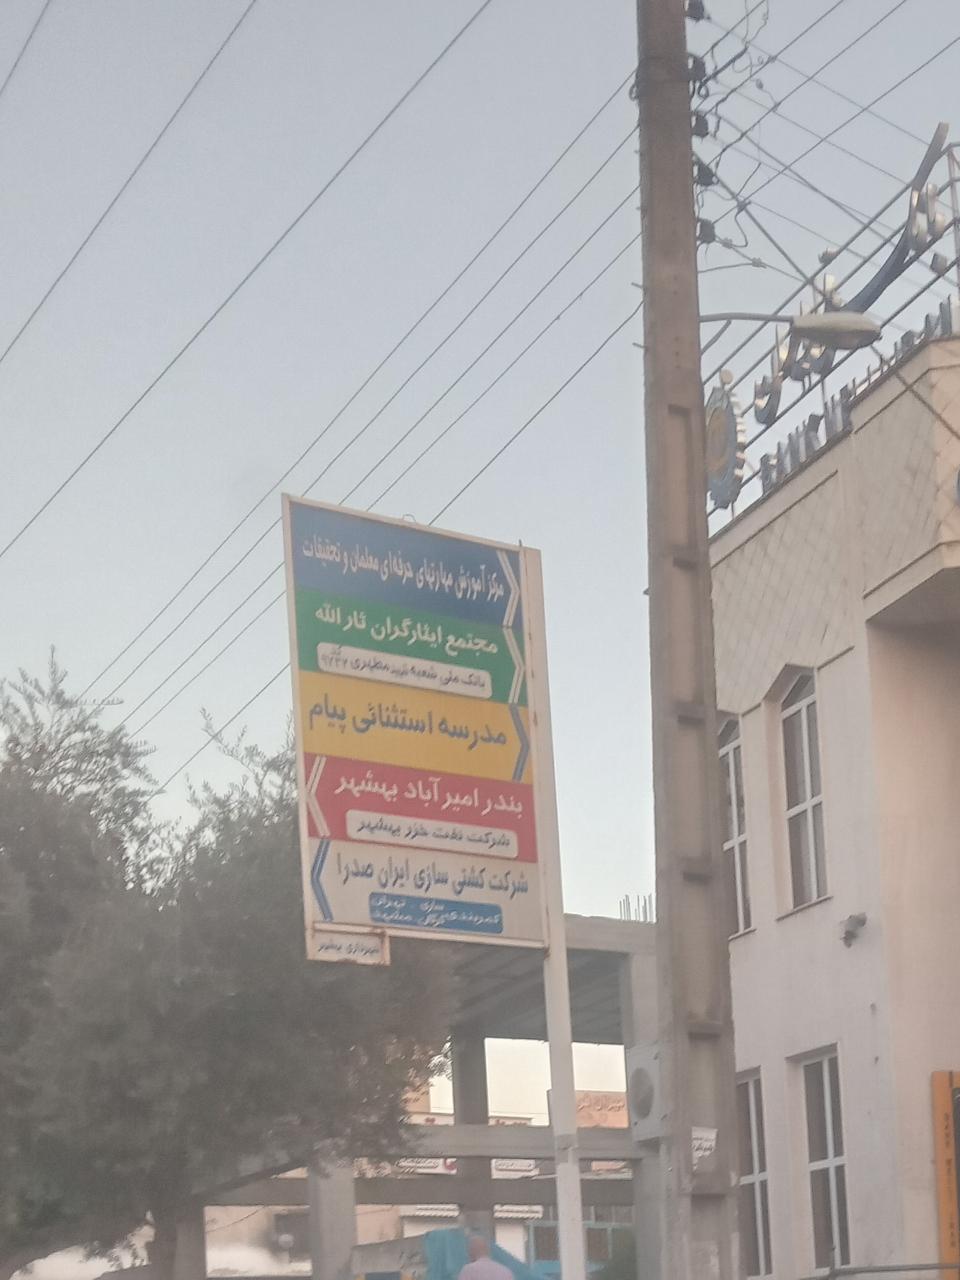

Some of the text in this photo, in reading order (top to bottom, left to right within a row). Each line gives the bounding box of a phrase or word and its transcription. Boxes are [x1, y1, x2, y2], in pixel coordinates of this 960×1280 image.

[342, 553, 349, 575] و
[349, 544, 379, 573] معلمان
[455, 563, 486, 601] آموزش
[487, 572, 504, 600] مرکز
[370, 617, 442, 649] ایثارگران
[445, 633, 498, 657] مجتمع
[461, 670, 486, 688] بانک
[309, 693, 347, 735] پیام
[438, 716, 507, 750] مدرسه
[334, 769, 399, 803] بهشهر
[481, 792, 523, 819] بندر
[356, 816, 401, 838] بهشهر
[467, 829, 511, 849] شرکت
[336, 852, 528, 900] شرکت کشتی سازی ایران صدرا
